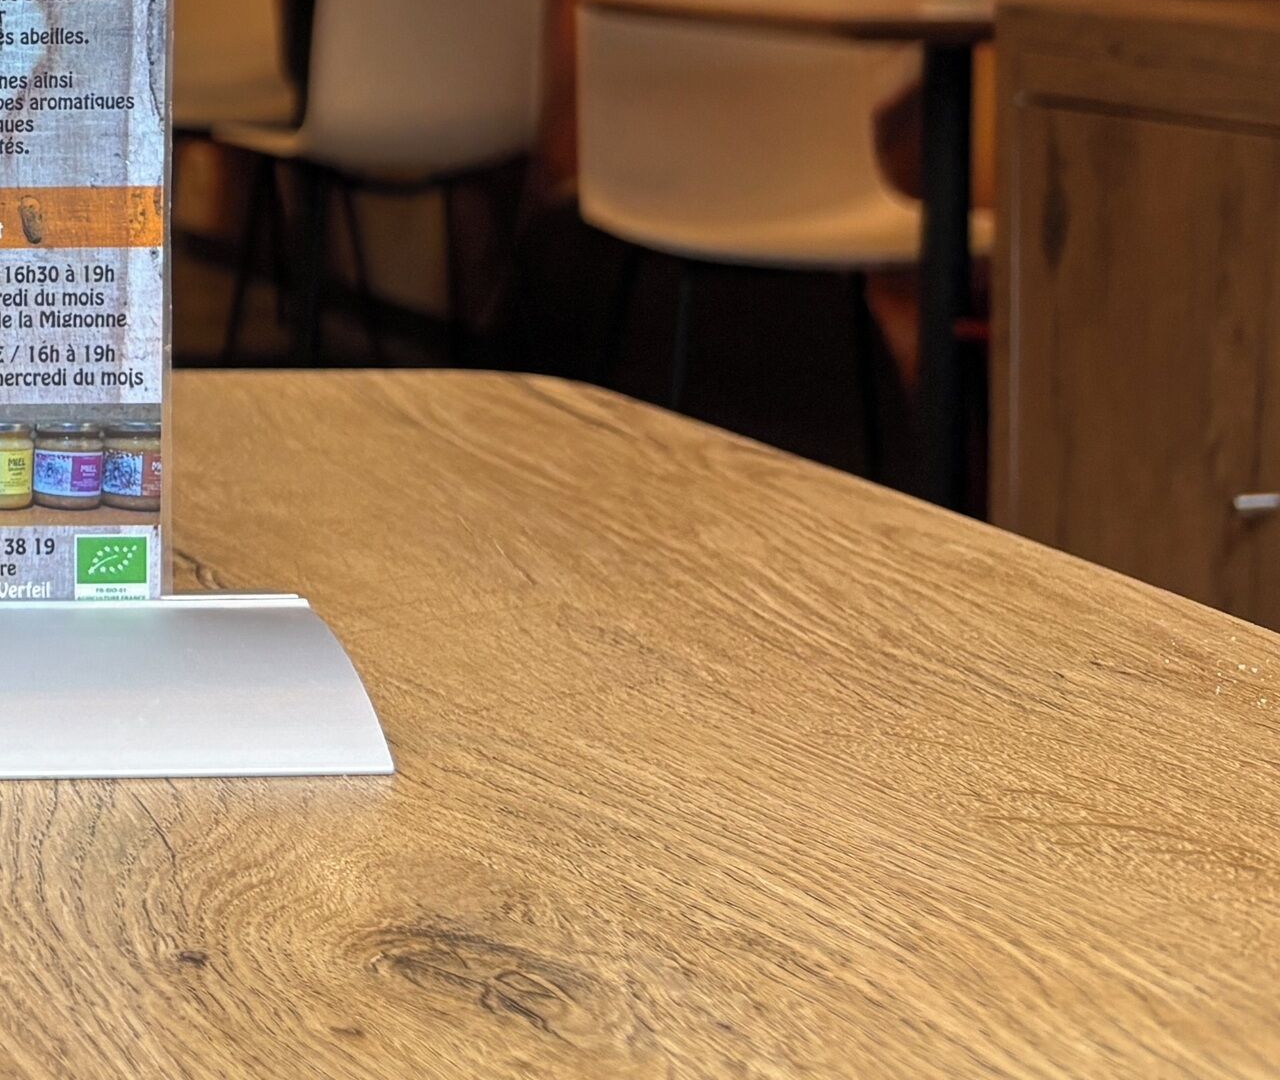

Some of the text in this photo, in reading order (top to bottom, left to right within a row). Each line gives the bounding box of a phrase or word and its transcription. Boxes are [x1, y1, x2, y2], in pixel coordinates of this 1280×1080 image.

[33, 71, 73, 89] ainsi
[30, 94, 135, 110] aromatiques
[4, 266, 59, 283] 16h30
[65, 264, 75, 283] à
[83, 266, 114, 282] 19h
[34, 289, 55, 306] du
[61, 289, 104, 306] mois
[10, 346, 18, 363] /
[28, 345, 59, 362] 16h
[65, 345, 75, 362] à
[84, 345, 114, 362] 19h
[4, 538, 28, 555] 38
[35, 538, 54, 555] 19
